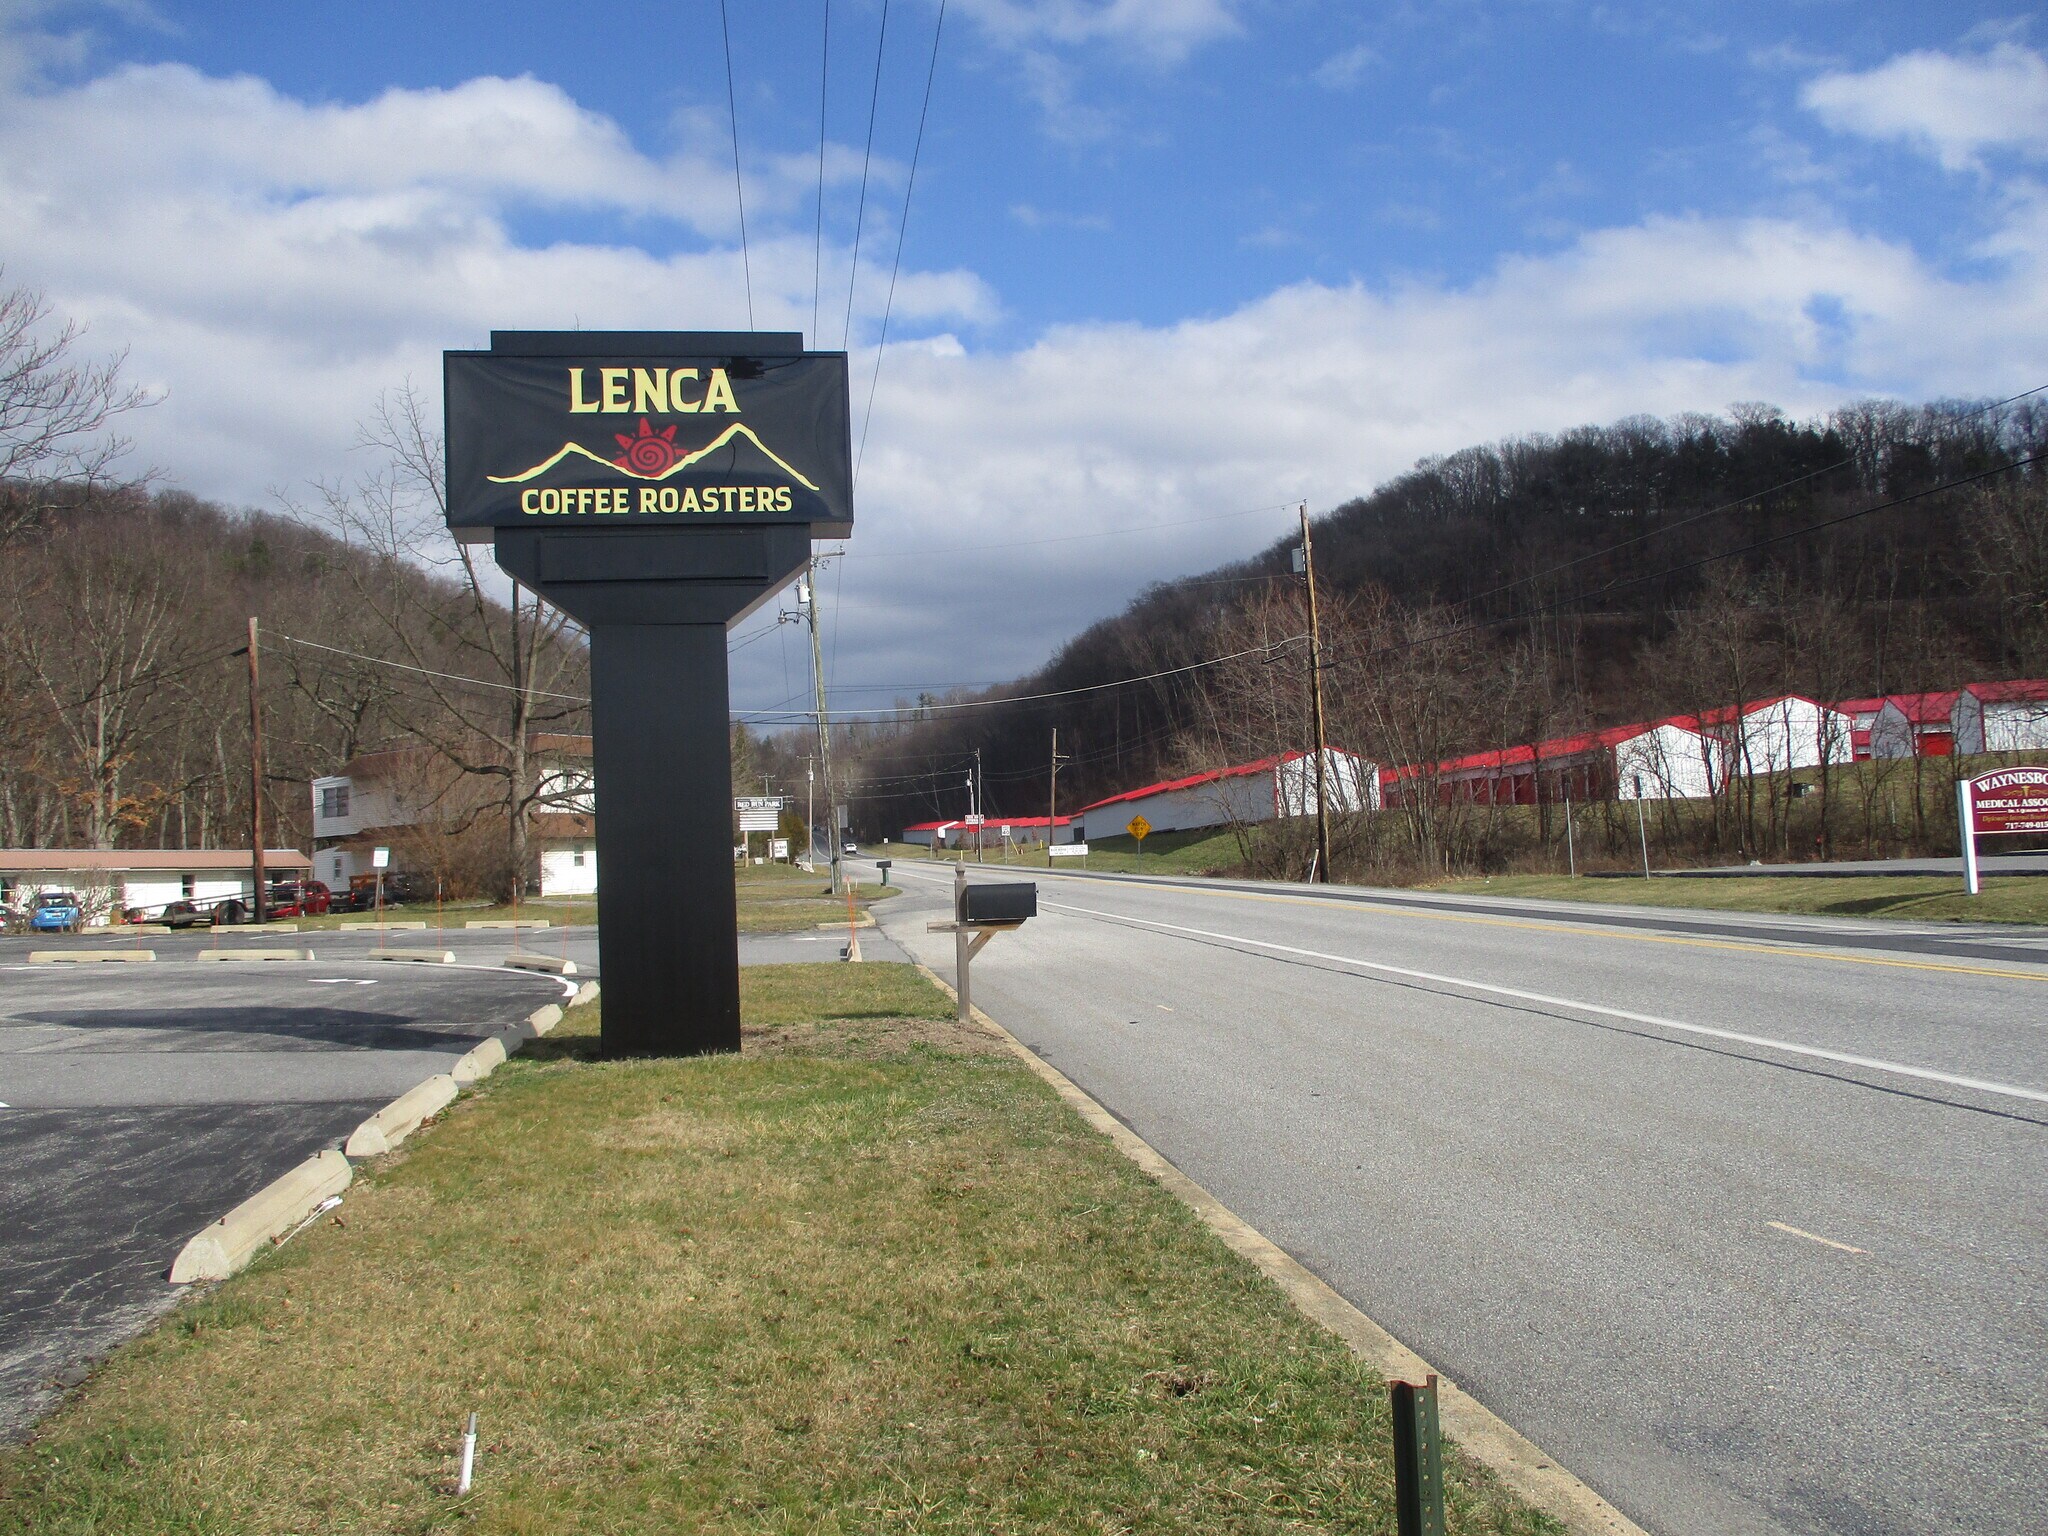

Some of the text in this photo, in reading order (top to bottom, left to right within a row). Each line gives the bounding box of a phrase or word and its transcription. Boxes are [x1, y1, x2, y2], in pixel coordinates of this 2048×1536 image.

[568, 368, 742, 413] LENCA
[521, 486, 792, 514] COFFEE ROASTERS
[1976, 800, 2020, 808] MEDICAL
